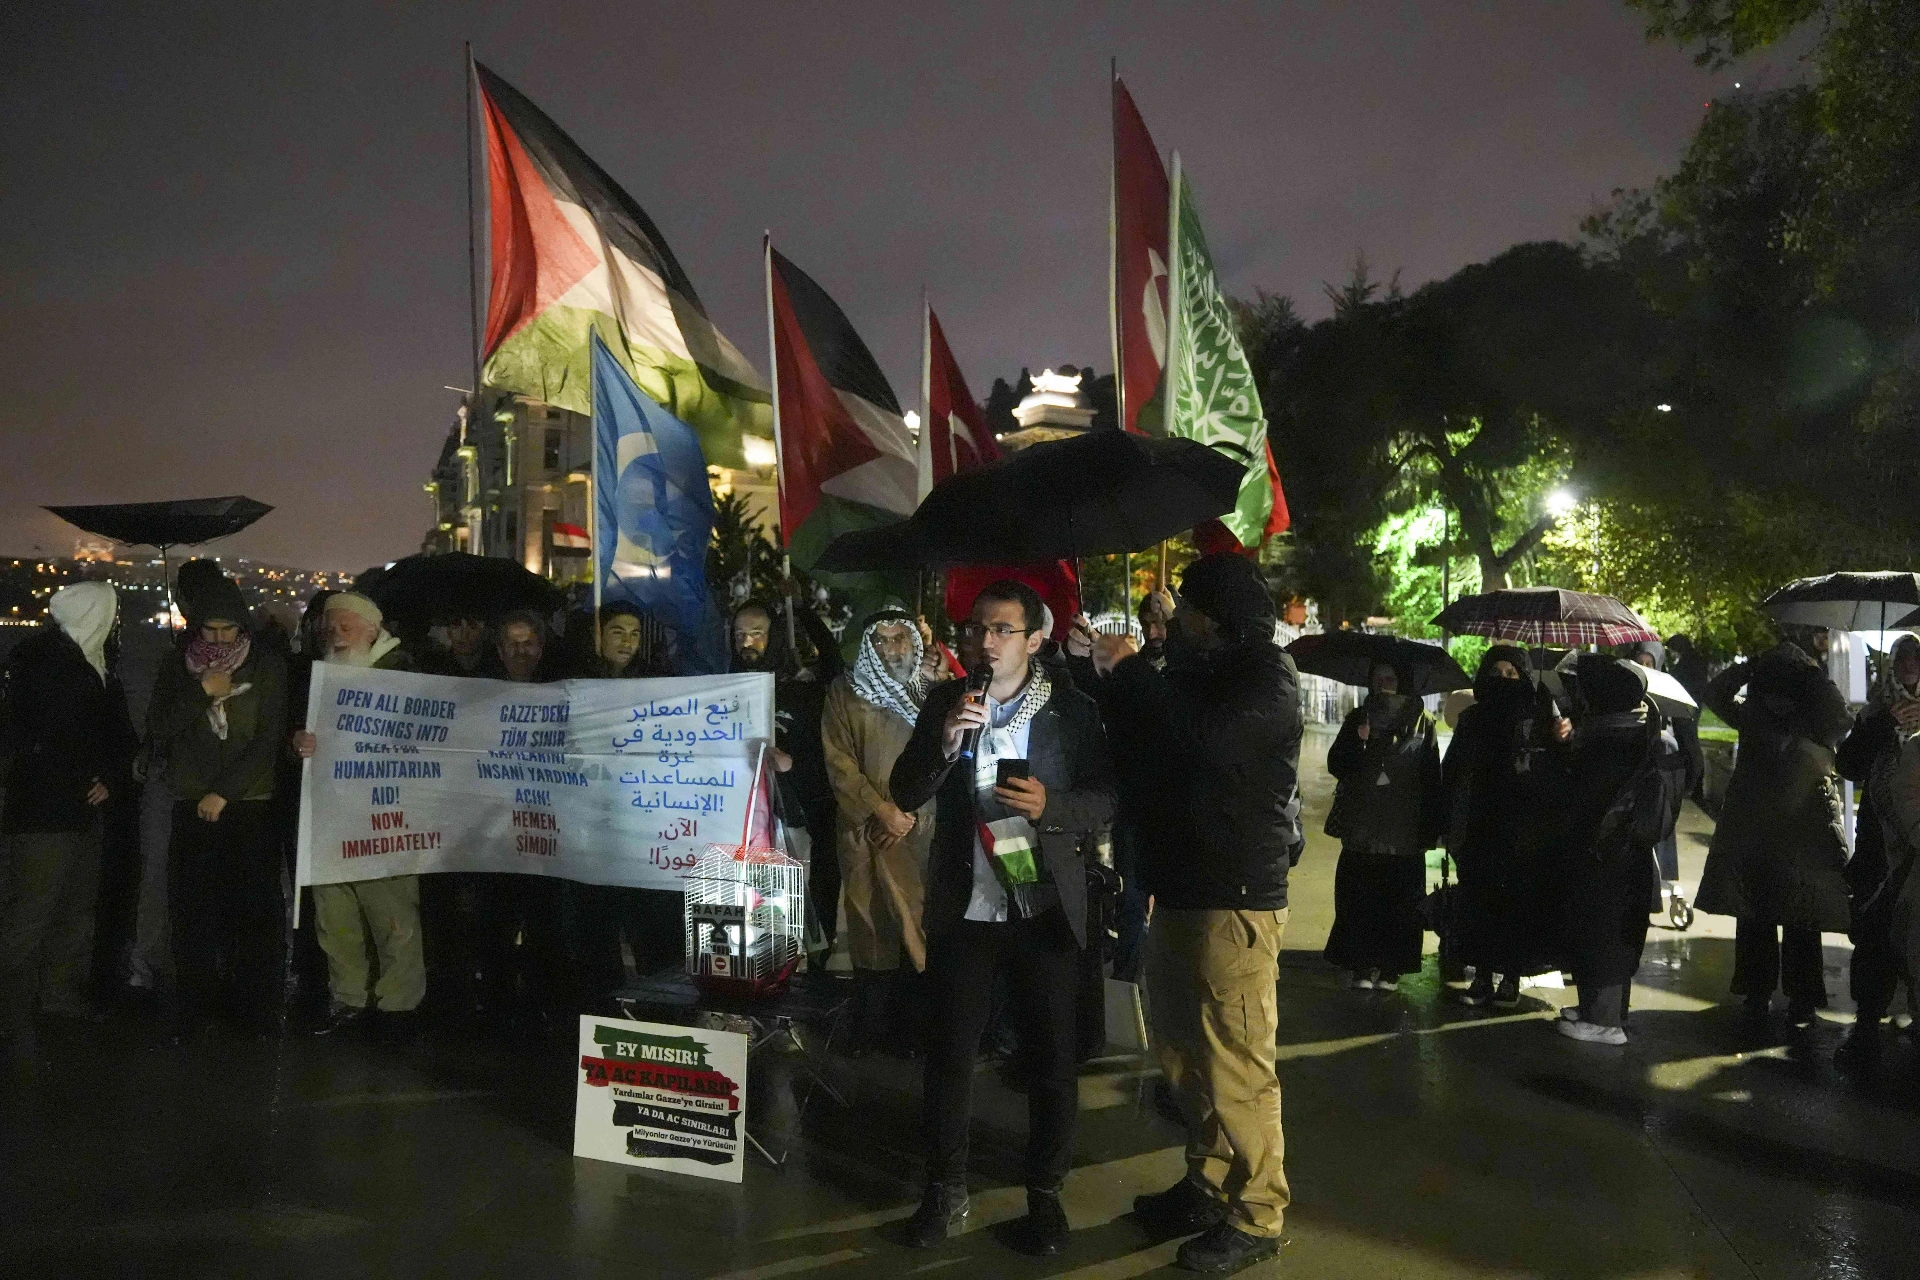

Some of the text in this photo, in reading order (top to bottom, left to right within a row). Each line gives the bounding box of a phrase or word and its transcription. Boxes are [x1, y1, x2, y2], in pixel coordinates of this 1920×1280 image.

[336, 688, 456, 720] OPEN ALL BORDER
[500, 701, 570, 723] GAZZE'DEKİ
[627, 698, 699, 723] المعابر
[336, 713, 449, 743] CROSSINGS INTO
[500, 727, 566, 748] TÜM SINIR
[612, 722, 743, 753] الحدودية في
[334, 760, 442, 779] HUMANITARIAN
[476, 759, 589, 787] İNSANİ YARDIMA
[619, 769, 736, 788] للمساعدات
[371, 787, 400, 805] AID!
[515, 788, 551, 808] AÇIN!
[371, 811, 409, 831] NOW,
[512, 810, 560, 834] HEMEN,
[342, 832, 441, 859] IMMEDIATELY!
[516, 832, 557, 857] ŞİMDİ!
[693, 905, 746, 917] RAFAH
[616, 1041, 699, 1066] EY MISIR!
[585, 1063, 608, 1080] YA
[613, 1087, 724, 1111] Yardımlar Gazze'ye Girsin!
[637, 1105, 650, 1116] YA
[651, 1109, 664, 1121] DA
[681, 1117, 730, 1137] SINIRLARI
[634, 1128, 736, 1151] Milyonlar Gazze'ye Yürüsün!
